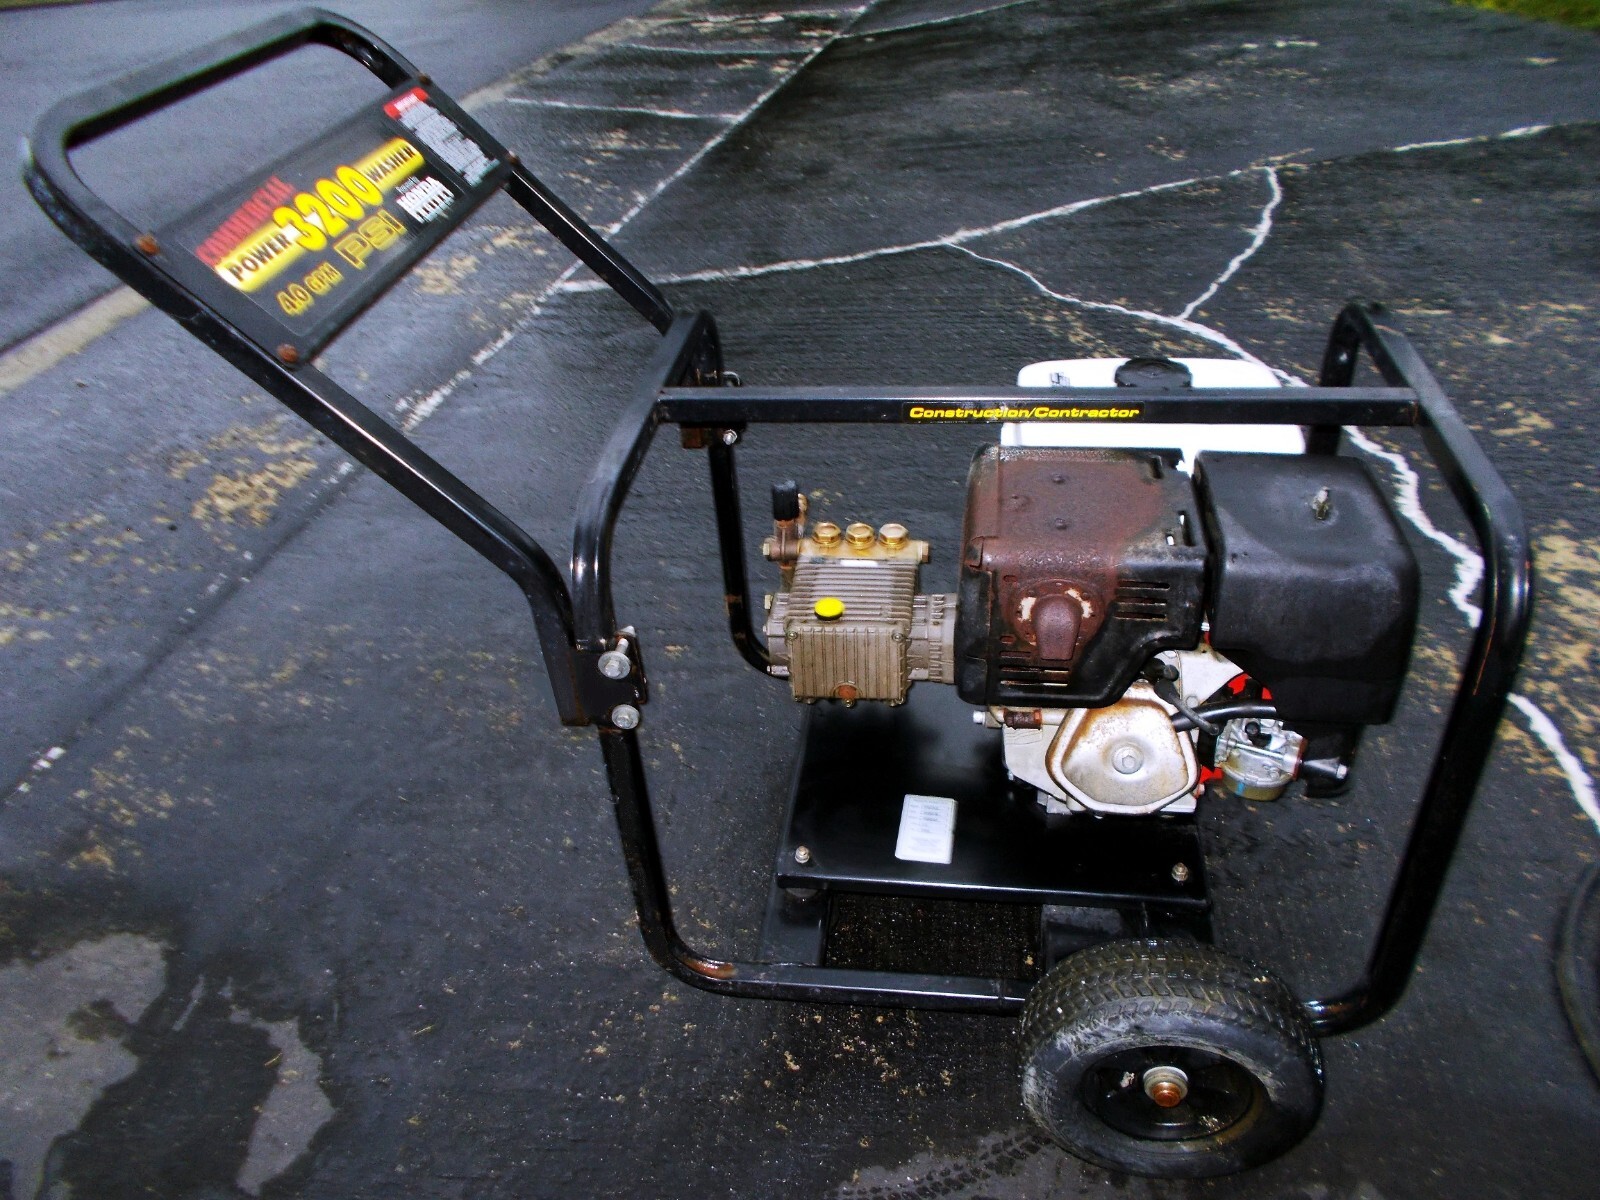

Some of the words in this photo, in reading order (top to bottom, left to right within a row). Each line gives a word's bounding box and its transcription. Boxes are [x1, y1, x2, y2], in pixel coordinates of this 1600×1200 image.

[228, 231, 293, 282] POWER
[272, 164, 383, 252] 3200
[365, 143, 416, 184] WASHER
[396, 176, 443, 213] HONDA
[333, 208, 407, 270] PSI
[304, 261, 344, 296] GPM
[908, 406, 1140, 420] Construction/Contractor
